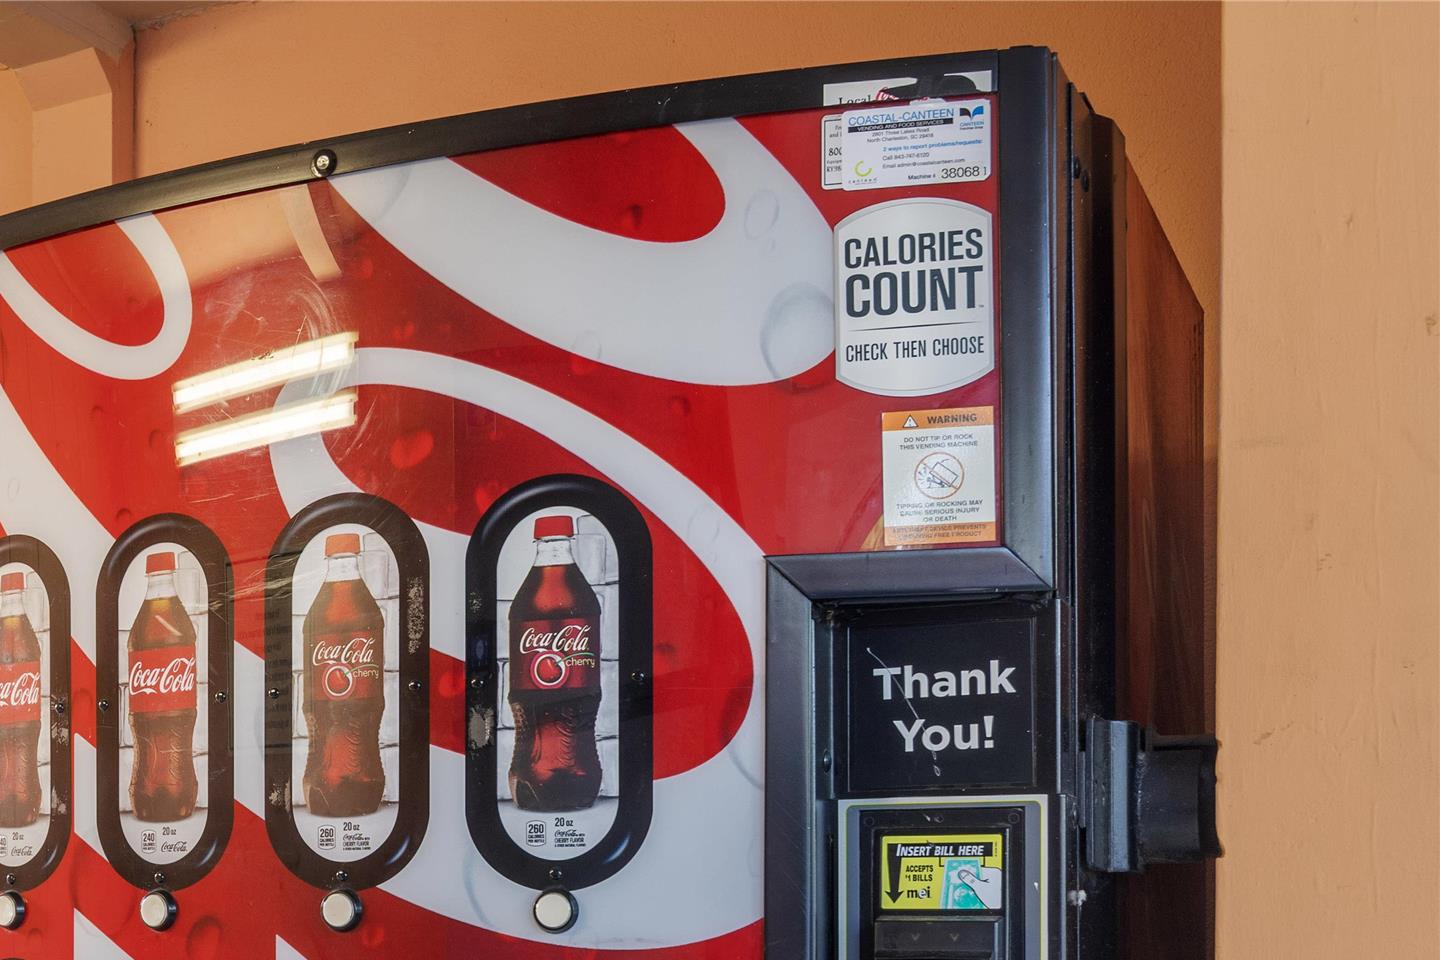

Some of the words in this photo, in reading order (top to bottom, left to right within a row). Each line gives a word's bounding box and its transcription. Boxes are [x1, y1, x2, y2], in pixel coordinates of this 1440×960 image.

[848, 108, 954, 127] COASTAL-CANTEEN
[856, 124, 884, 133] VENDING
[885, 122, 897, 130] AND
[898, 121, 915, 129] FOOD
[916, 119, 944, 127] SERVICES
[941, 166, 980, 179] 38068
[844, 228, 983, 269] CALORIES
[845, 265, 983, 318] COUNT
[845, 342, 888, 362] CHECK
[893, 339, 927, 359] THEN
[933, 335, 985, 356] CHOOSE
[926, 413, 978, 424] WARNING
[968, 499, 983, 507] MAY
[924, 508, 954, 516] SERIOUS
[520, 625, 592, 654] Coca-Cola
[313, 637, 376, 666] Coca-Cola
[565, 657, 595, 668] cherry
[130, 657, 195, 695] Coca-Cola
[352, 669, 379, 679] cherry
[872, 659, 1017, 701] Thank
[892, 715, 995, 752] You!
[343, 821, 352, 831] 20
[555, 817, 565, 827] 20
[162, 826, 170, 836] 20
[320, 828, 334, 838] 260
[528, 824, 544, 834] 260
[143, 832, 155, 842] 240
[934, 845, 955, 856] BILL
[958, 845, 985, 856] HERE
[905, 865, 934, 873] ACCEPTS
[912, 874, 933, 882] BILLS
